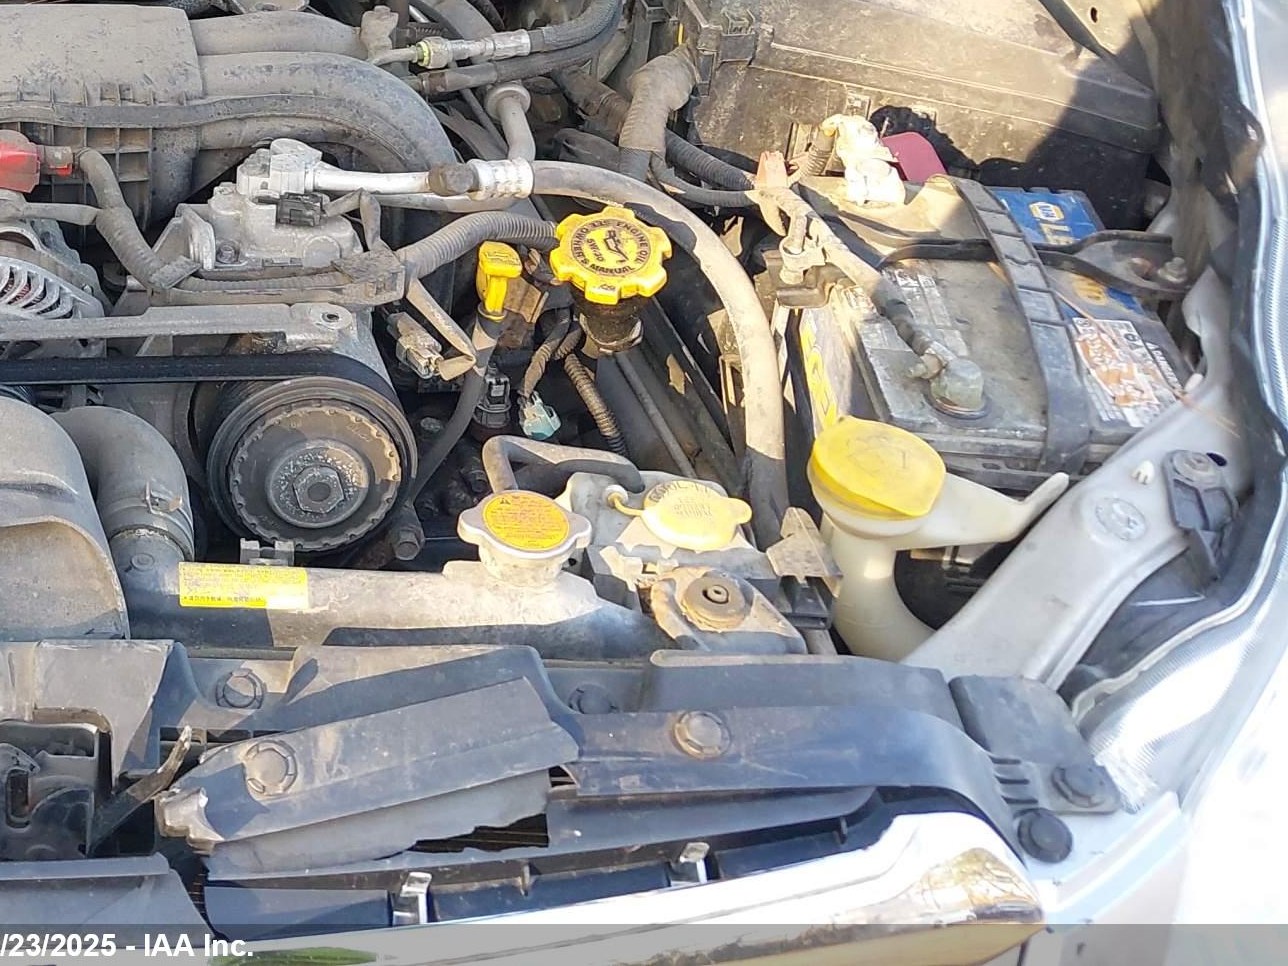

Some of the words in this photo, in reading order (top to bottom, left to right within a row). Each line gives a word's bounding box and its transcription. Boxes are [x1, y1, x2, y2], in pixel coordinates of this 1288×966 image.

[616, 222, 648, 247] ENGINE
[634, 249, 649, 265] OIL
[589, 264, 635, 275] MANUAL
